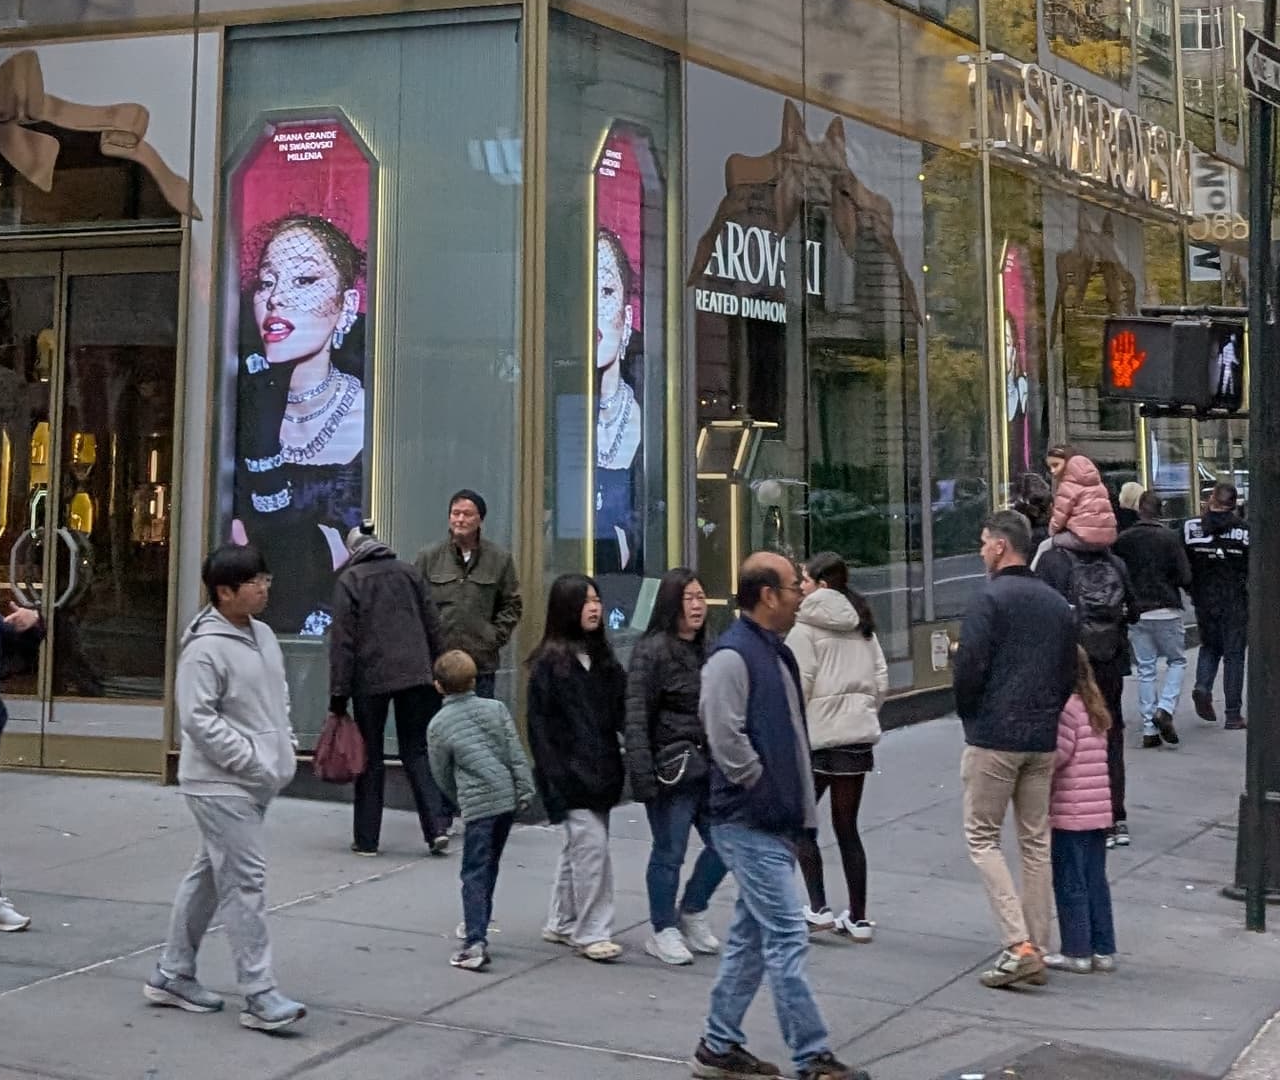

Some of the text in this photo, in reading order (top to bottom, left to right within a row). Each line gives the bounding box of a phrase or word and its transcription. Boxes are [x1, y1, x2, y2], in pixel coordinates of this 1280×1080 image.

[273, 130, 337, 142] ARIANA GRANDE
[279, 141, 334, 152] IN SWAROVSKI
[287, 152, 323, 161] MILLENIA
